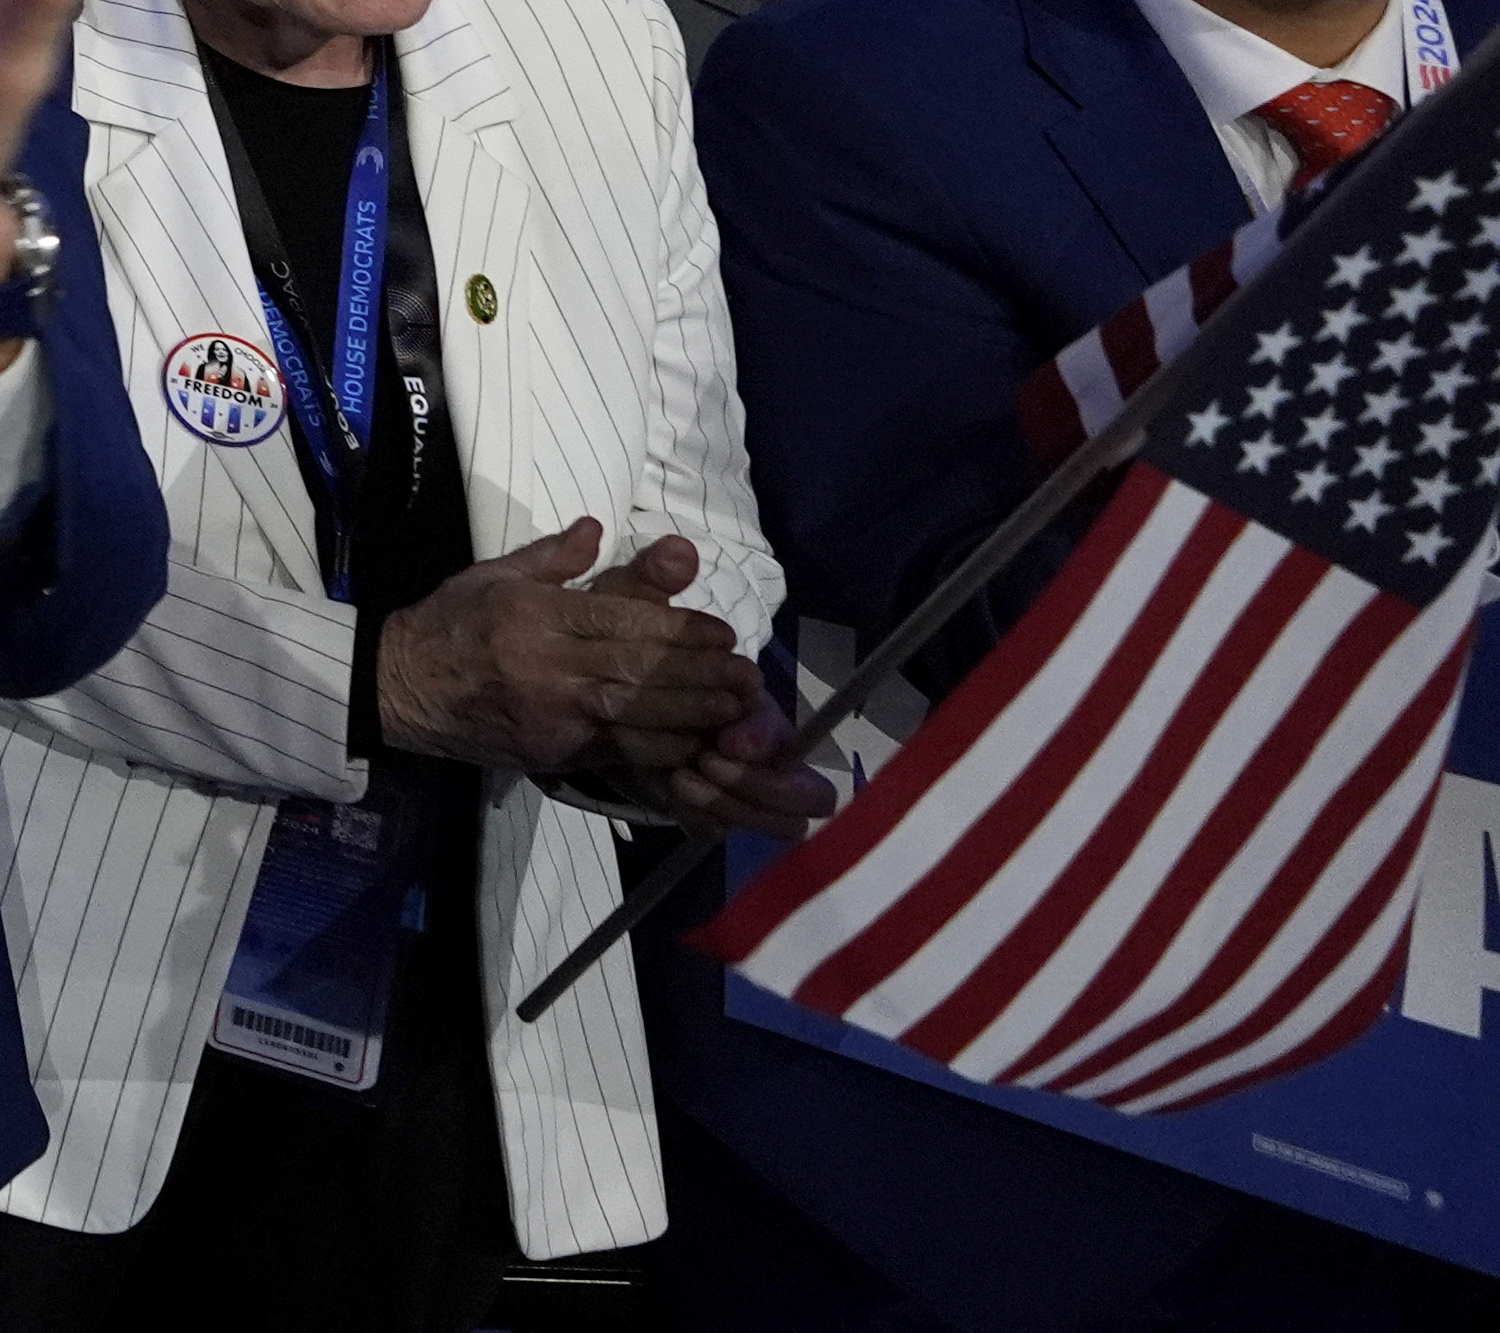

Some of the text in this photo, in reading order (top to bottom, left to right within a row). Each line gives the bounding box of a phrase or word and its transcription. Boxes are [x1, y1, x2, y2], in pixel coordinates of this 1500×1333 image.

[342, 200, 377, 414] HOUSE DEMOCRATS
[184, 379, 263, 409] FREEDOM
